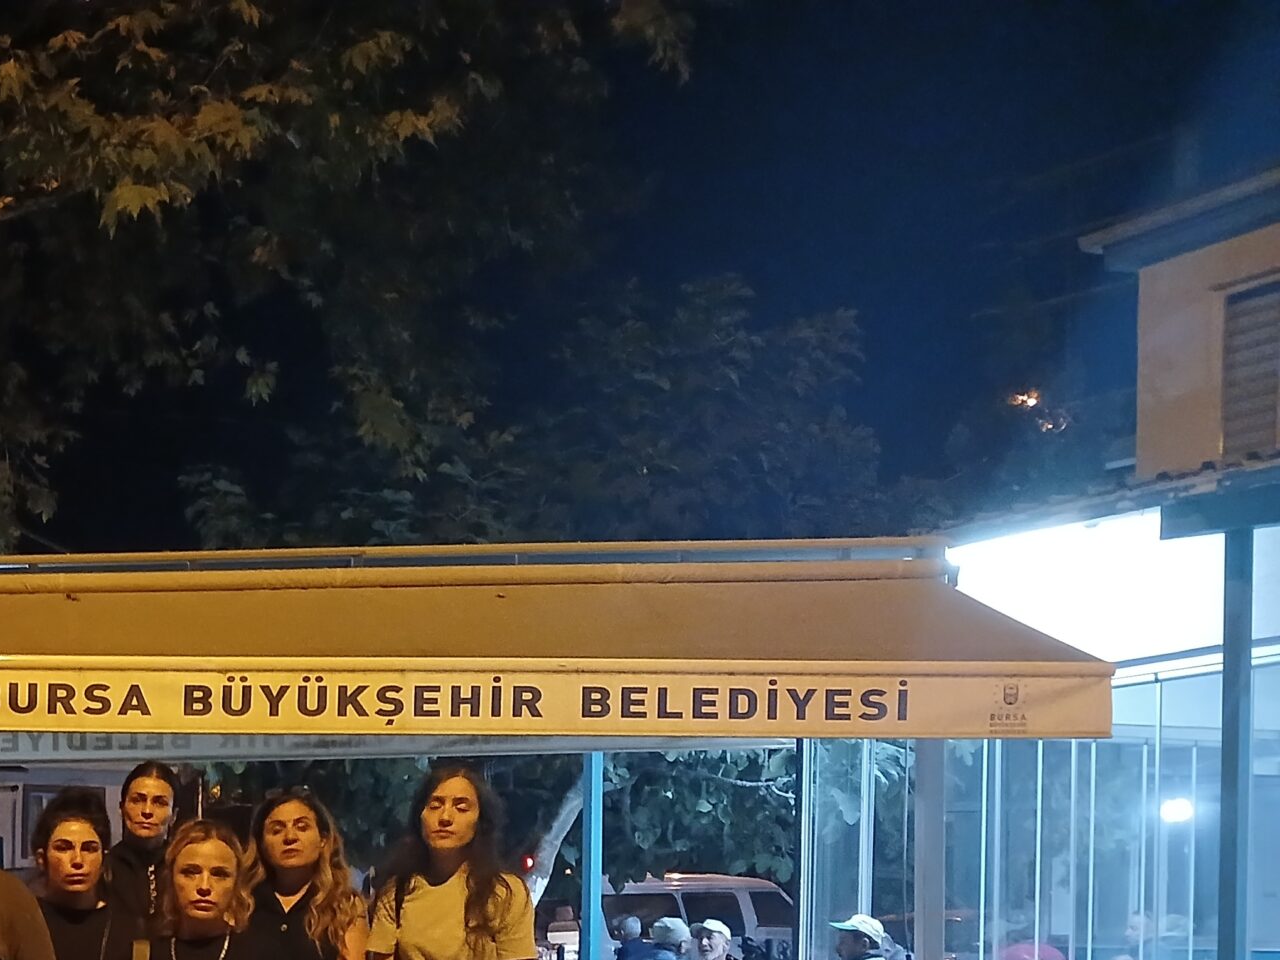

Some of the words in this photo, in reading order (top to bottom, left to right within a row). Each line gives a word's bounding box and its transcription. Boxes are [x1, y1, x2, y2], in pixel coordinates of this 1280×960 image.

[183, 675, 543, 726] BÜYÜKŞEHİR
[581, 678, 909, 721] BELEDİYESİ
[989, 713, 1027, 721] BURSA
